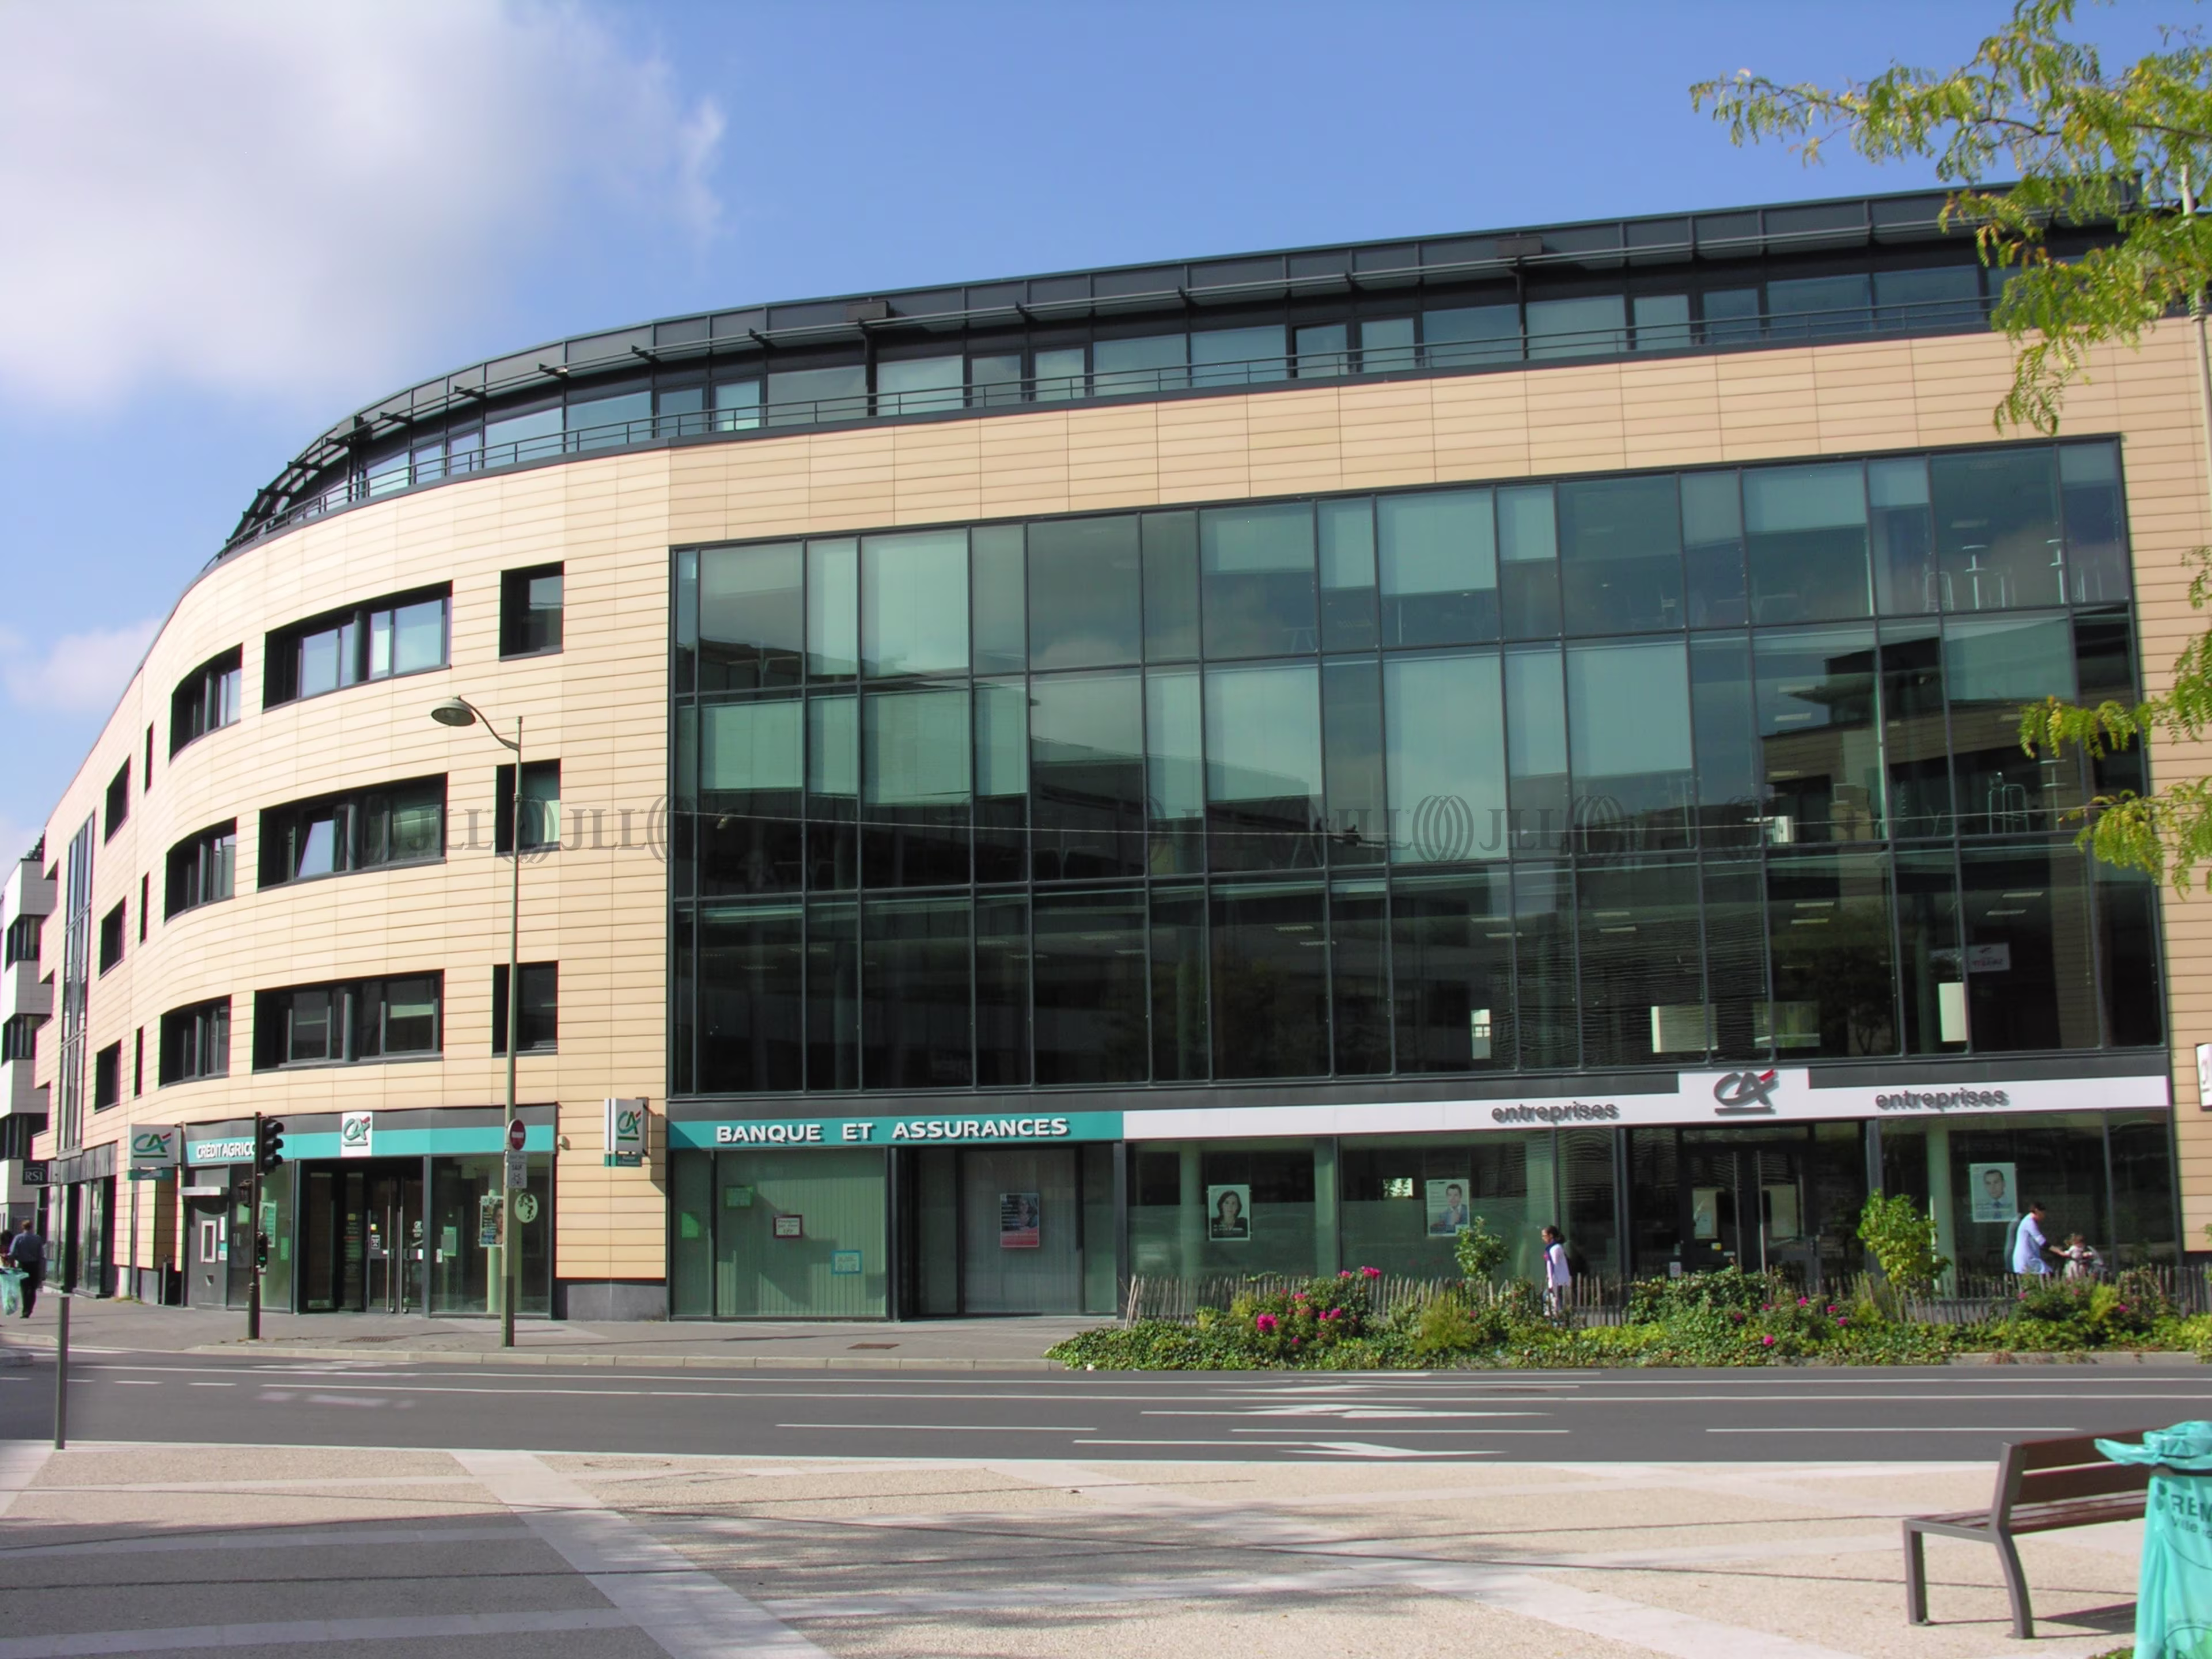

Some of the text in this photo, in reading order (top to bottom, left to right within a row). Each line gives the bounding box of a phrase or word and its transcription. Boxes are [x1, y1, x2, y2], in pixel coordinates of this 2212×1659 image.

[1875, 1086, 2009, 1111] entreprises
[1491, 1100, 1620, 1124] entreprises
[716, 1118, 1070, 1143] BANQUE ET ASSURANCES
[196, 1142, 222, 1158] CRÉDIT
[25, 1171, 43, 1181] RSI
